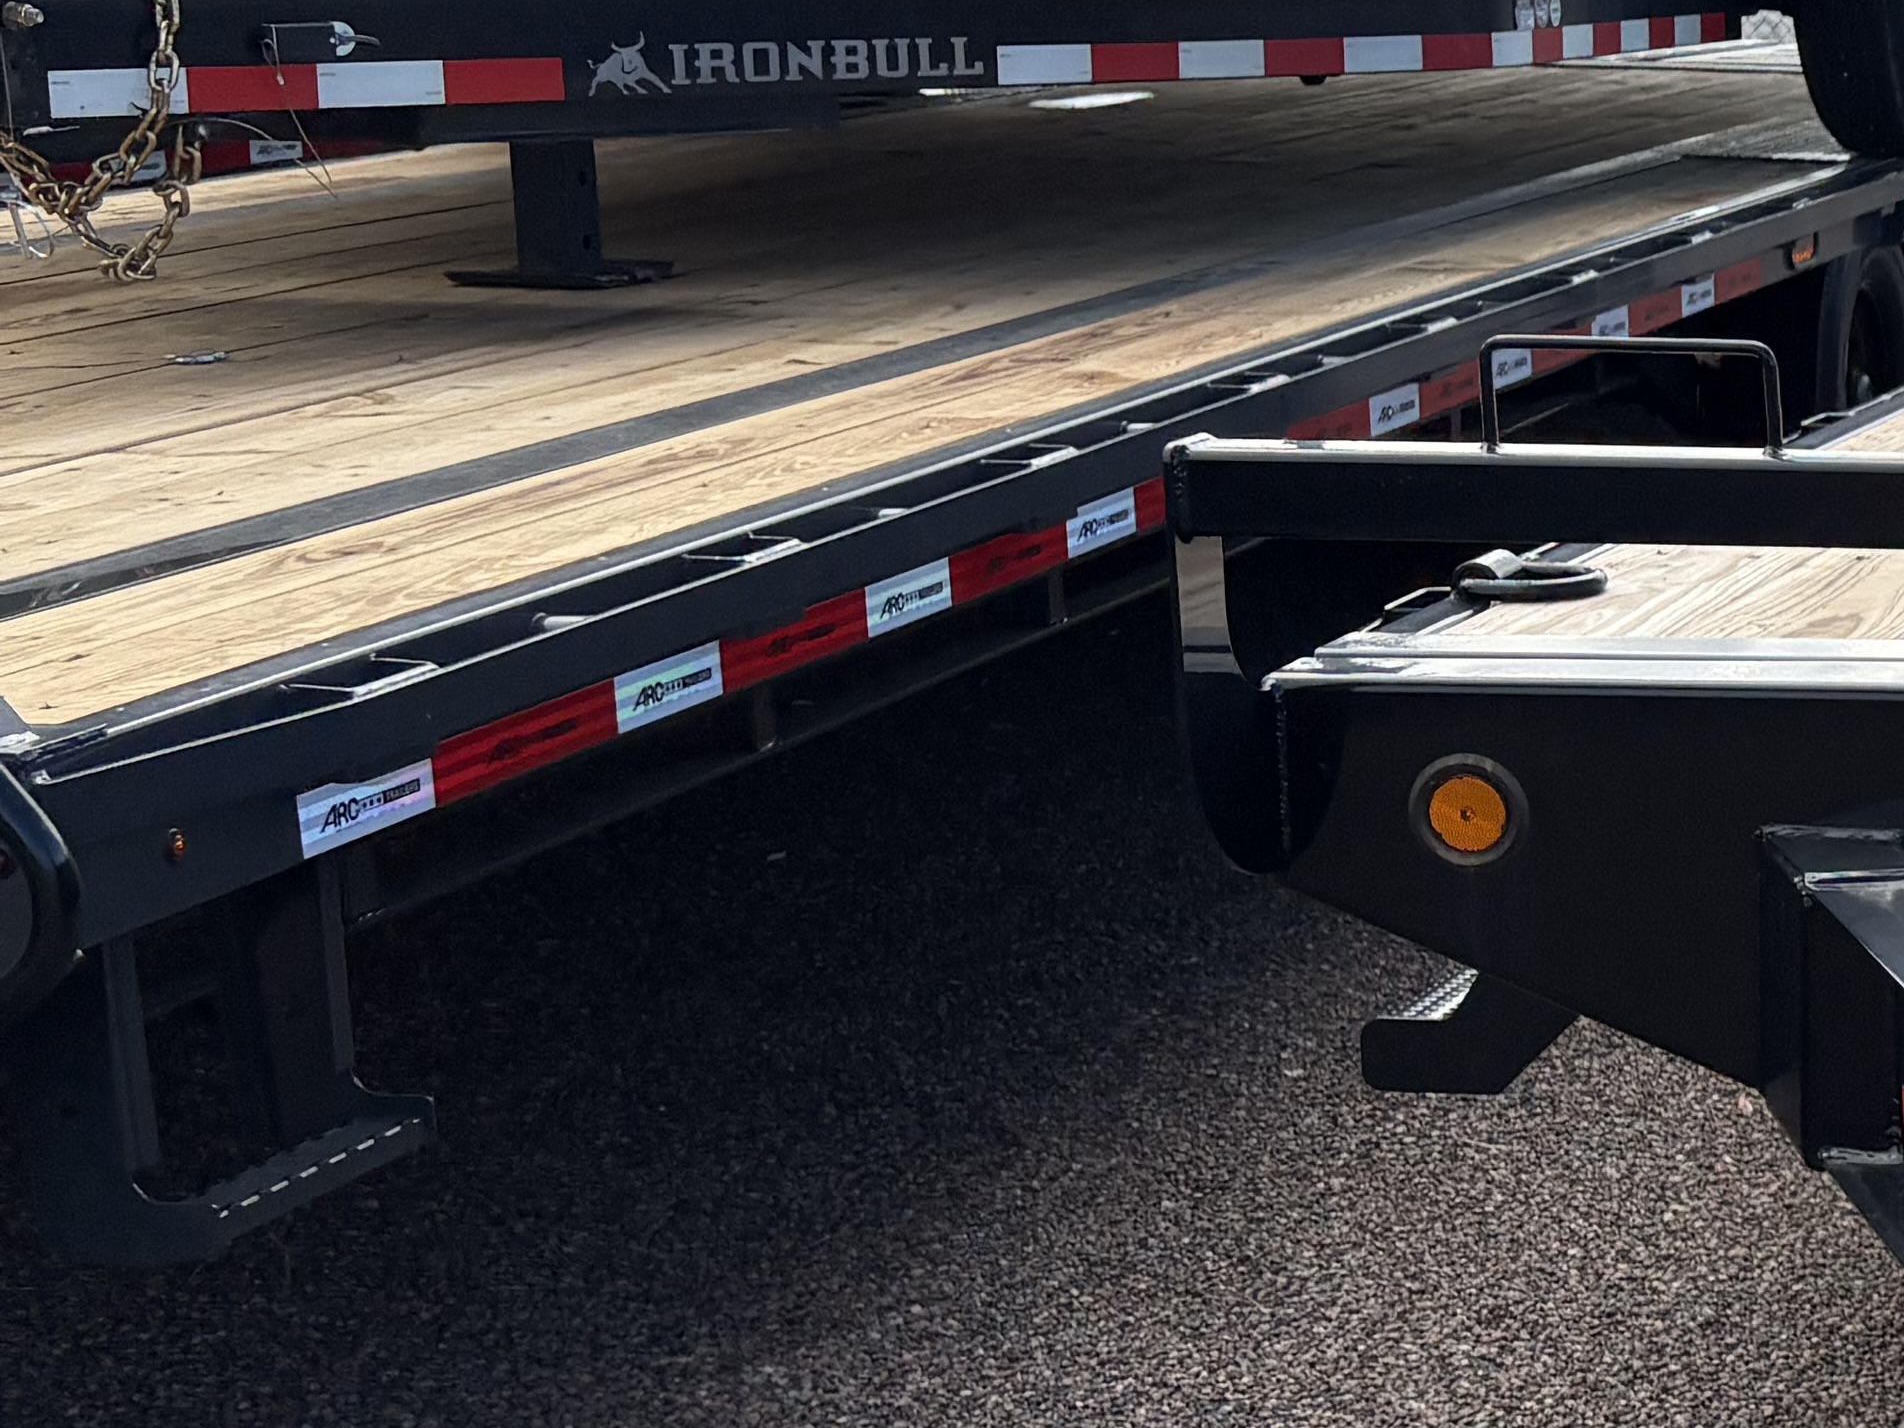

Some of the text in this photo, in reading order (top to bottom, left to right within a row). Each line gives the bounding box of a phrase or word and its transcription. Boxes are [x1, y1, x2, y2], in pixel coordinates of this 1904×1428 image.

[667, 36, 984, 86] IRONBULL
[632, 681, 665, 712] ARC
[320, 797, 361, 834] ARC
